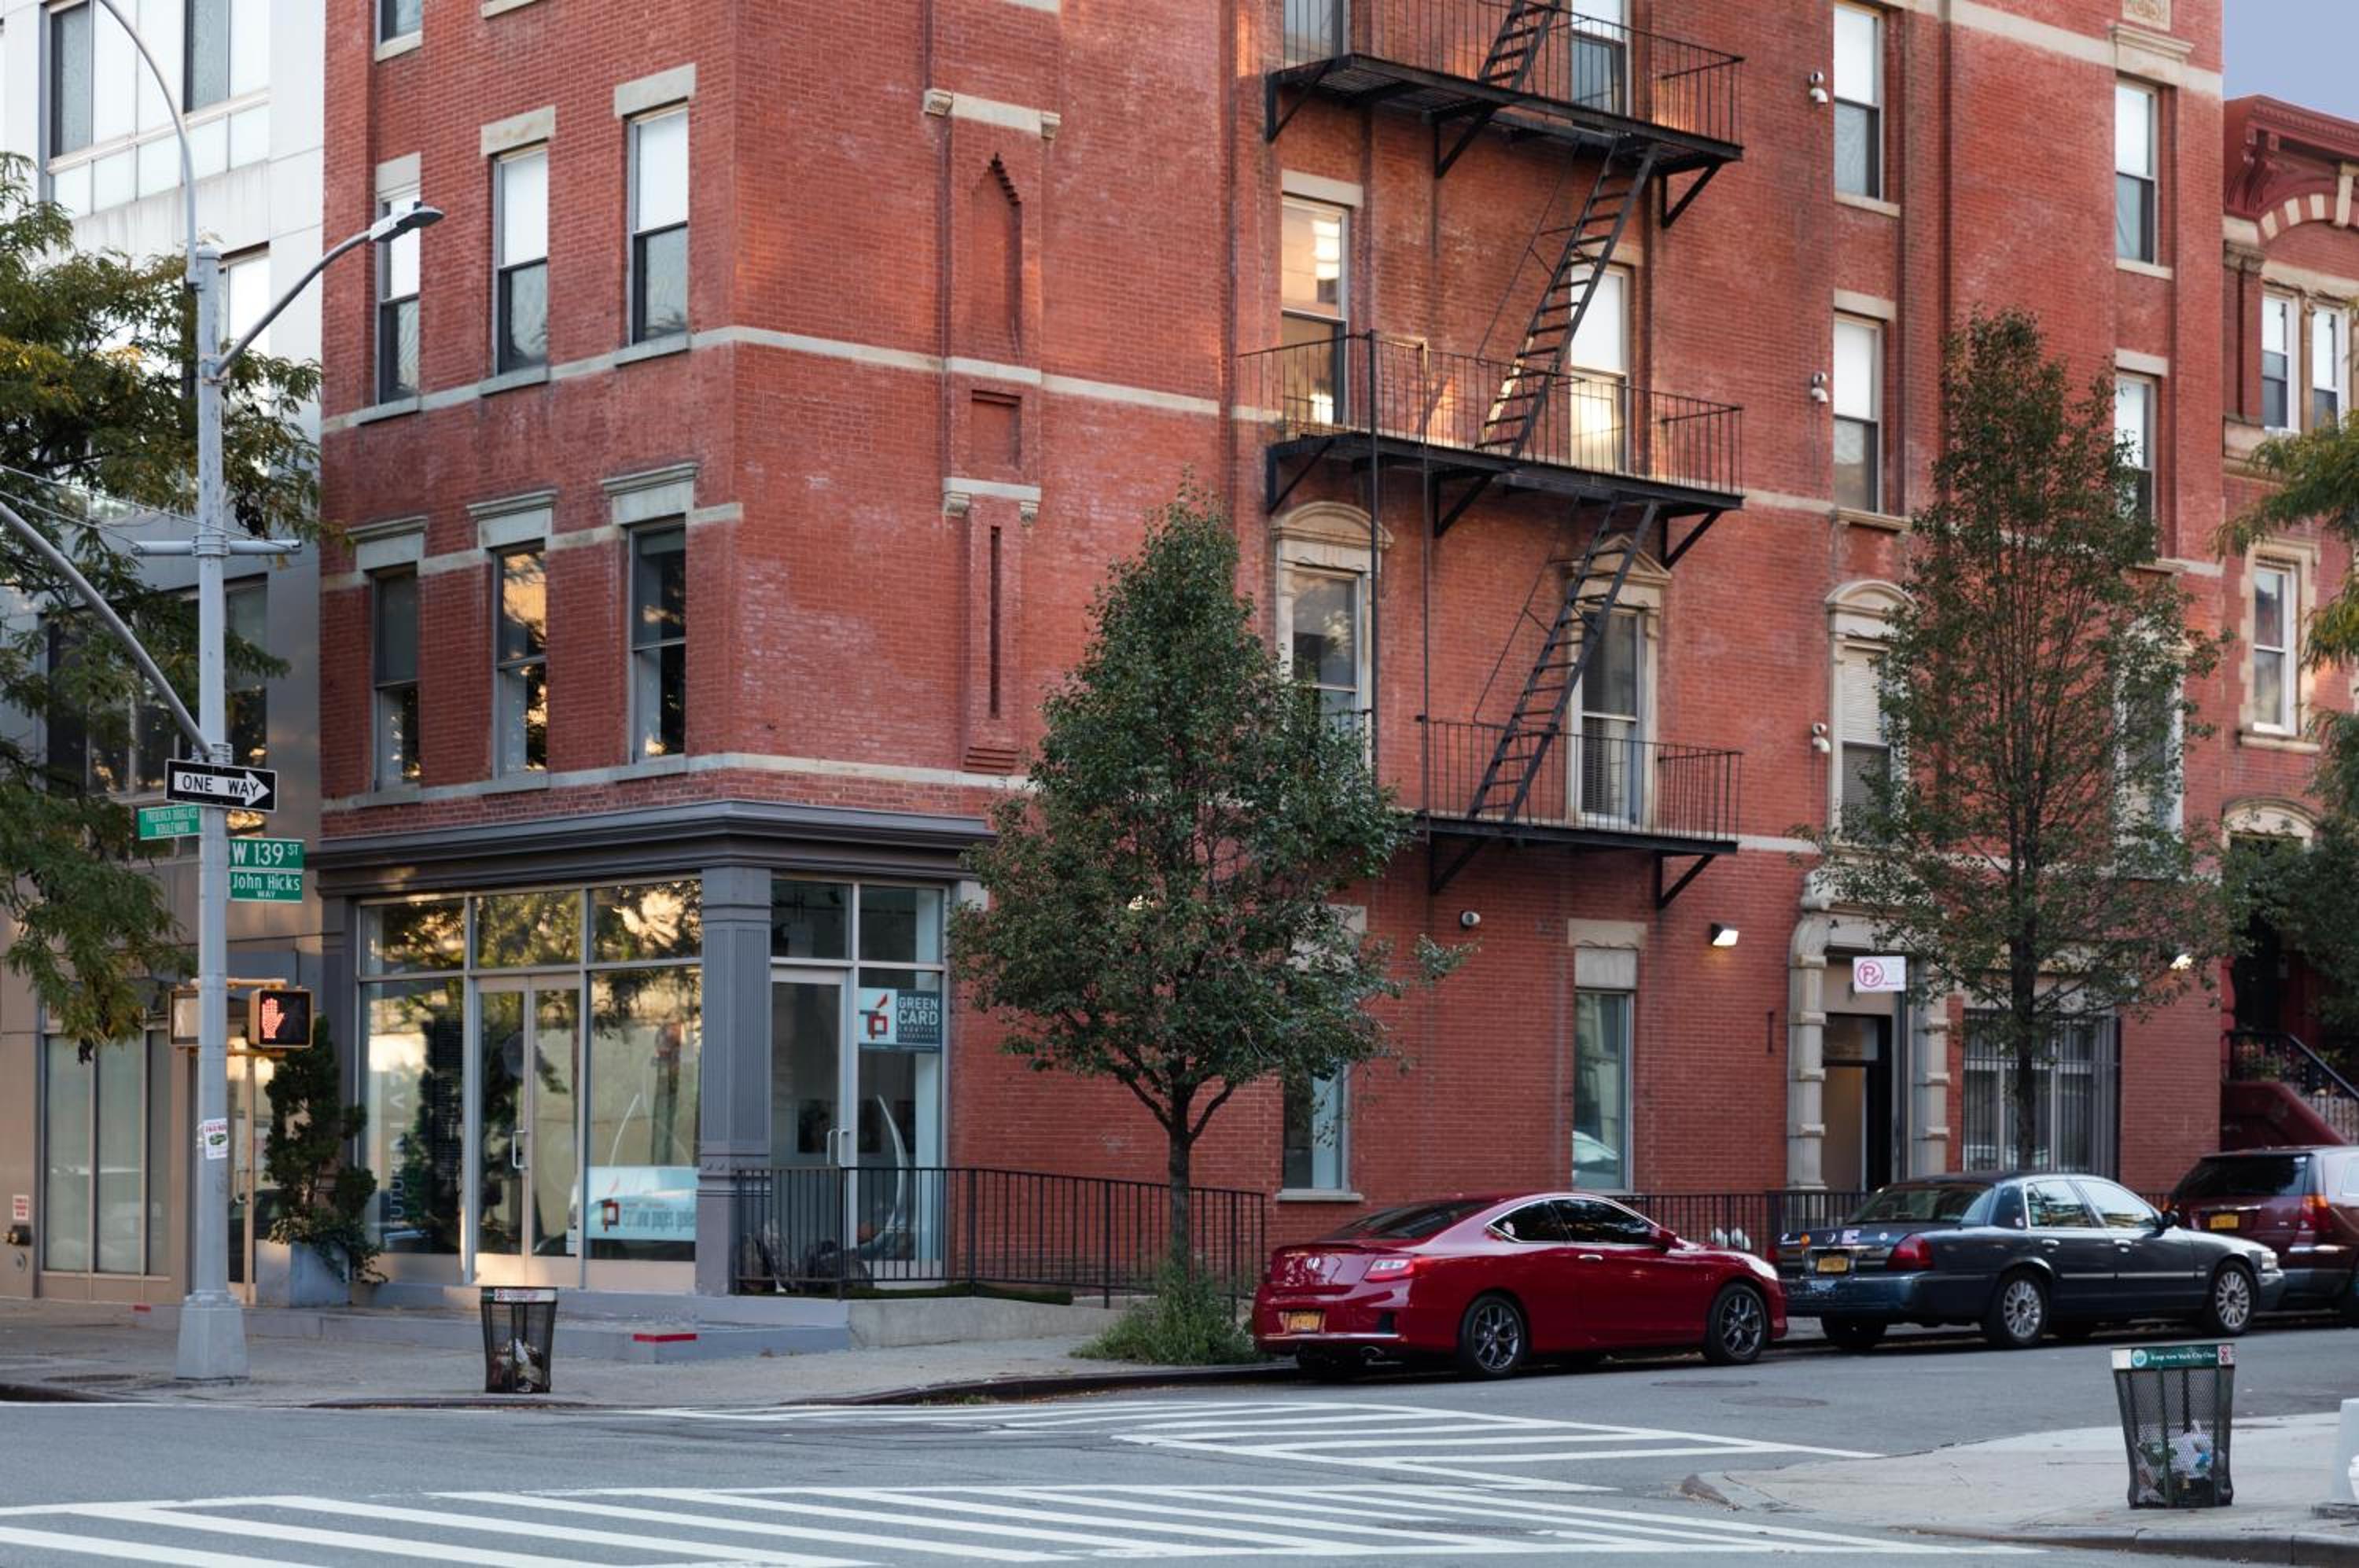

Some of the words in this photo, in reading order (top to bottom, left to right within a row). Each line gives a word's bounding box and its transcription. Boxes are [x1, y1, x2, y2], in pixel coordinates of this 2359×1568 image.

[182, 775, 213, 793] ONE
[227, 779, 259, 797] WAY
[232, 843, 247, 864] W
[254, 843, 284, 865] 139
[287, 844, 300, 856] ST
[233, 874, 262, 889] John
[267, 873, 300, 891] Hicks
[256, 890, 276, 899] WAY
[899, 996, 938, 1010] GREEN
[898, 1010, 939, 1025] CARD
